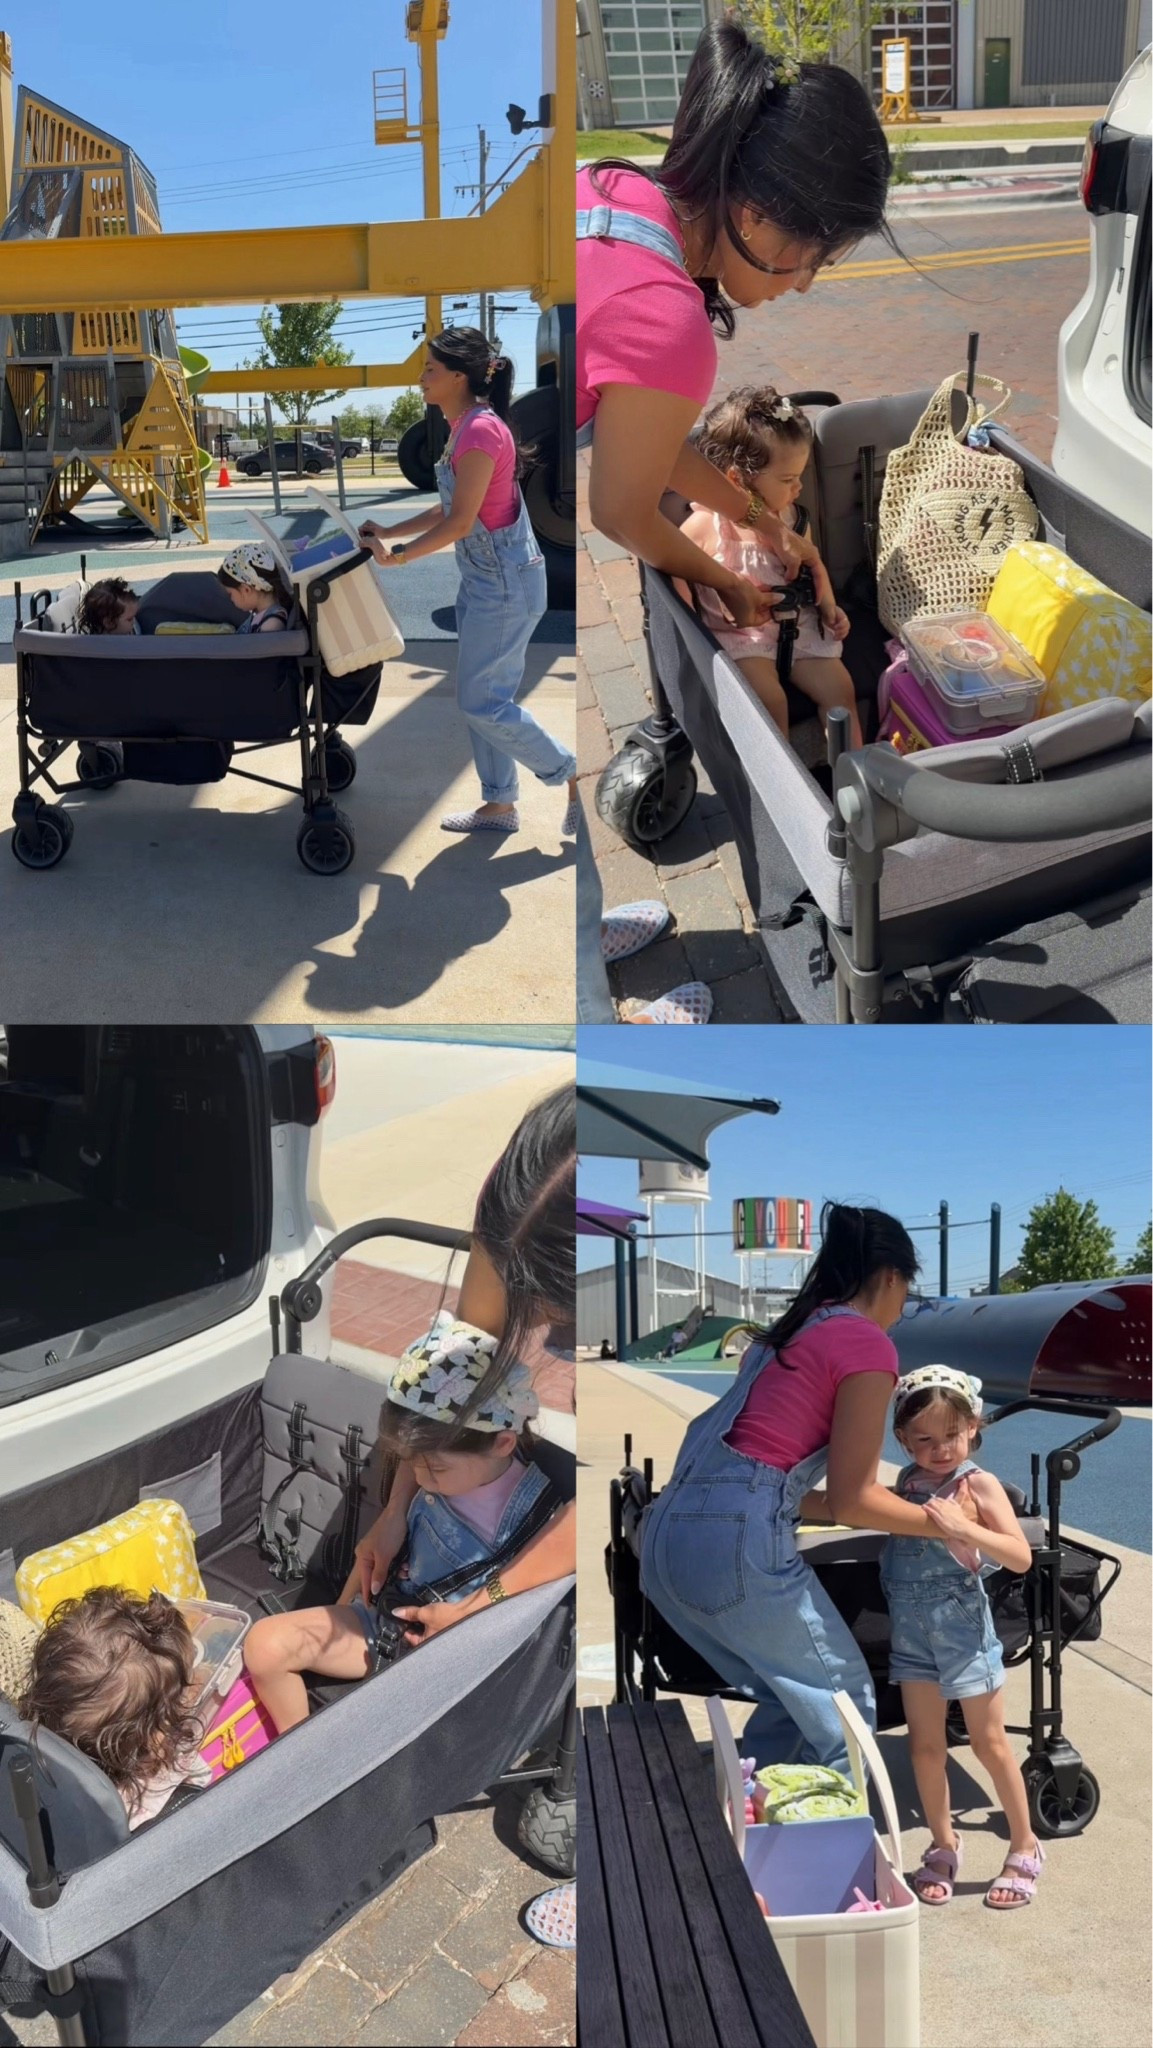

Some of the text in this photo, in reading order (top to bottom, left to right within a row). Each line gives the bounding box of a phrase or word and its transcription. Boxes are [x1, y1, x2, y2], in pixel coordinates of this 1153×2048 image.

[954, 494, 1014, 555] STRONG AS A MOTHER
[755, 1200, 786, 1245] YOU
